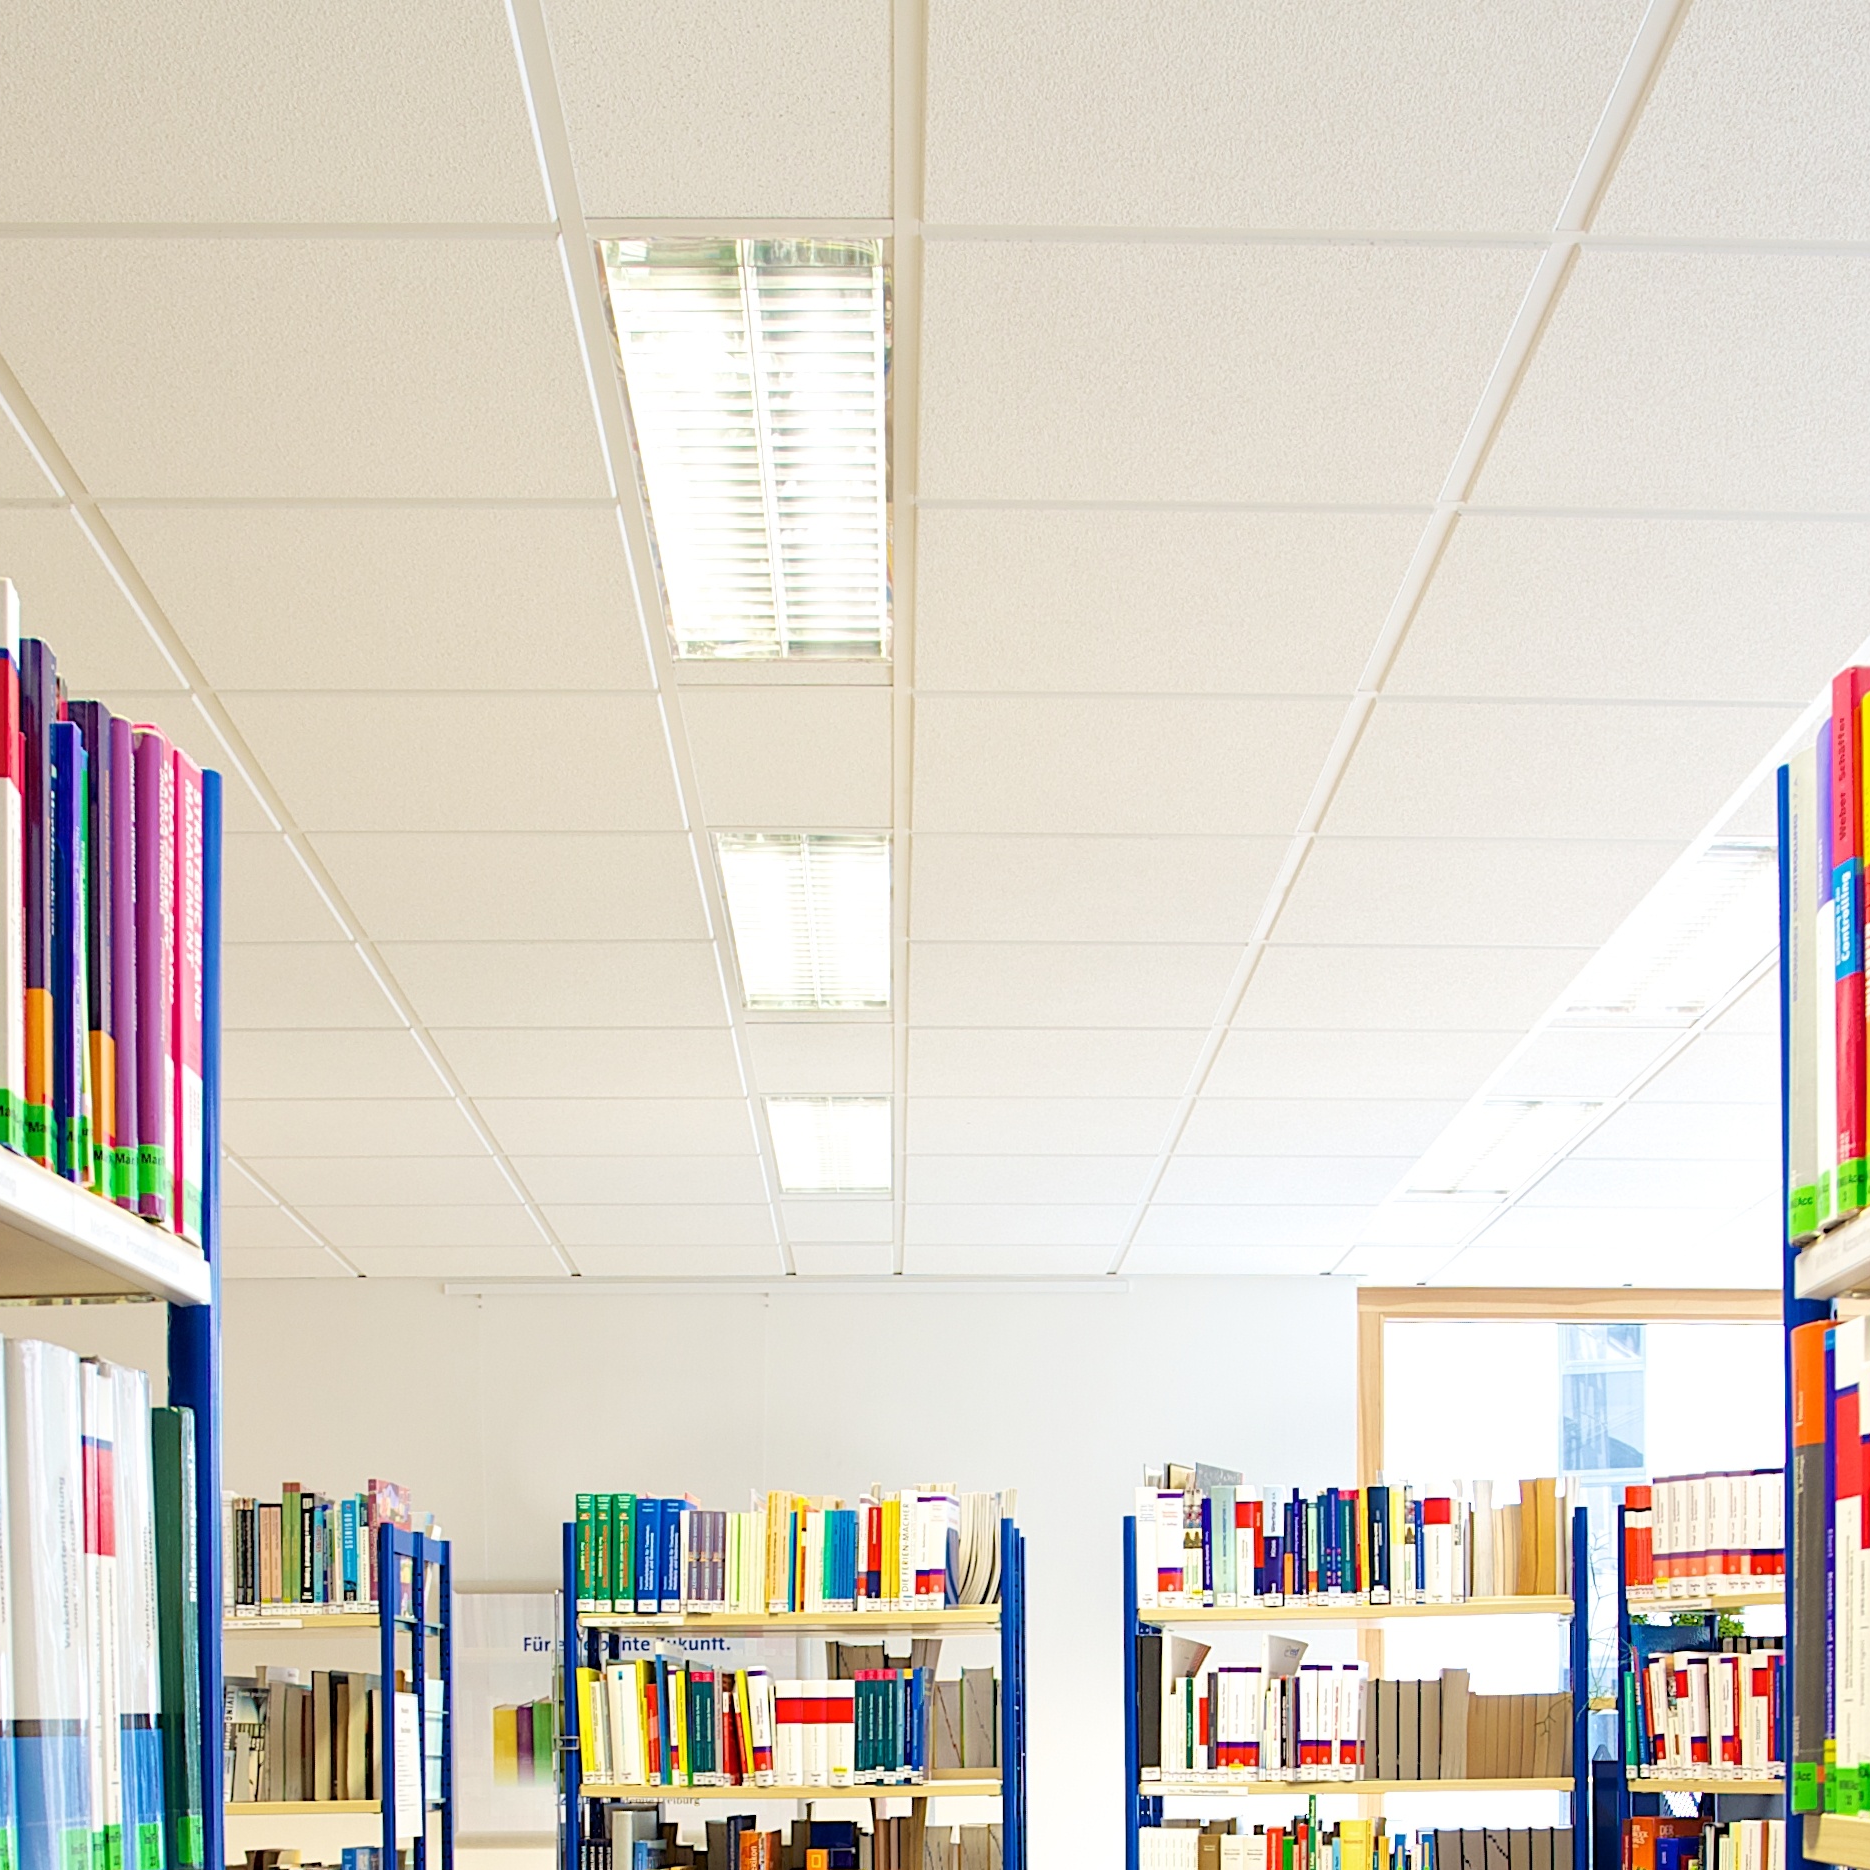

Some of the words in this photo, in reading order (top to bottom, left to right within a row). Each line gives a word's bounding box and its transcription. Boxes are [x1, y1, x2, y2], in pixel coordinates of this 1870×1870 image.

[184, 777, 196, 972] MANAGEMENT
[192, 943, 204, 1023] BRAND
[901, 1503, 910, 1575] FERIEN-MACHER
[901, 1580, 910, 1592] DIE
[523, 1637, 550, 1652] Für
